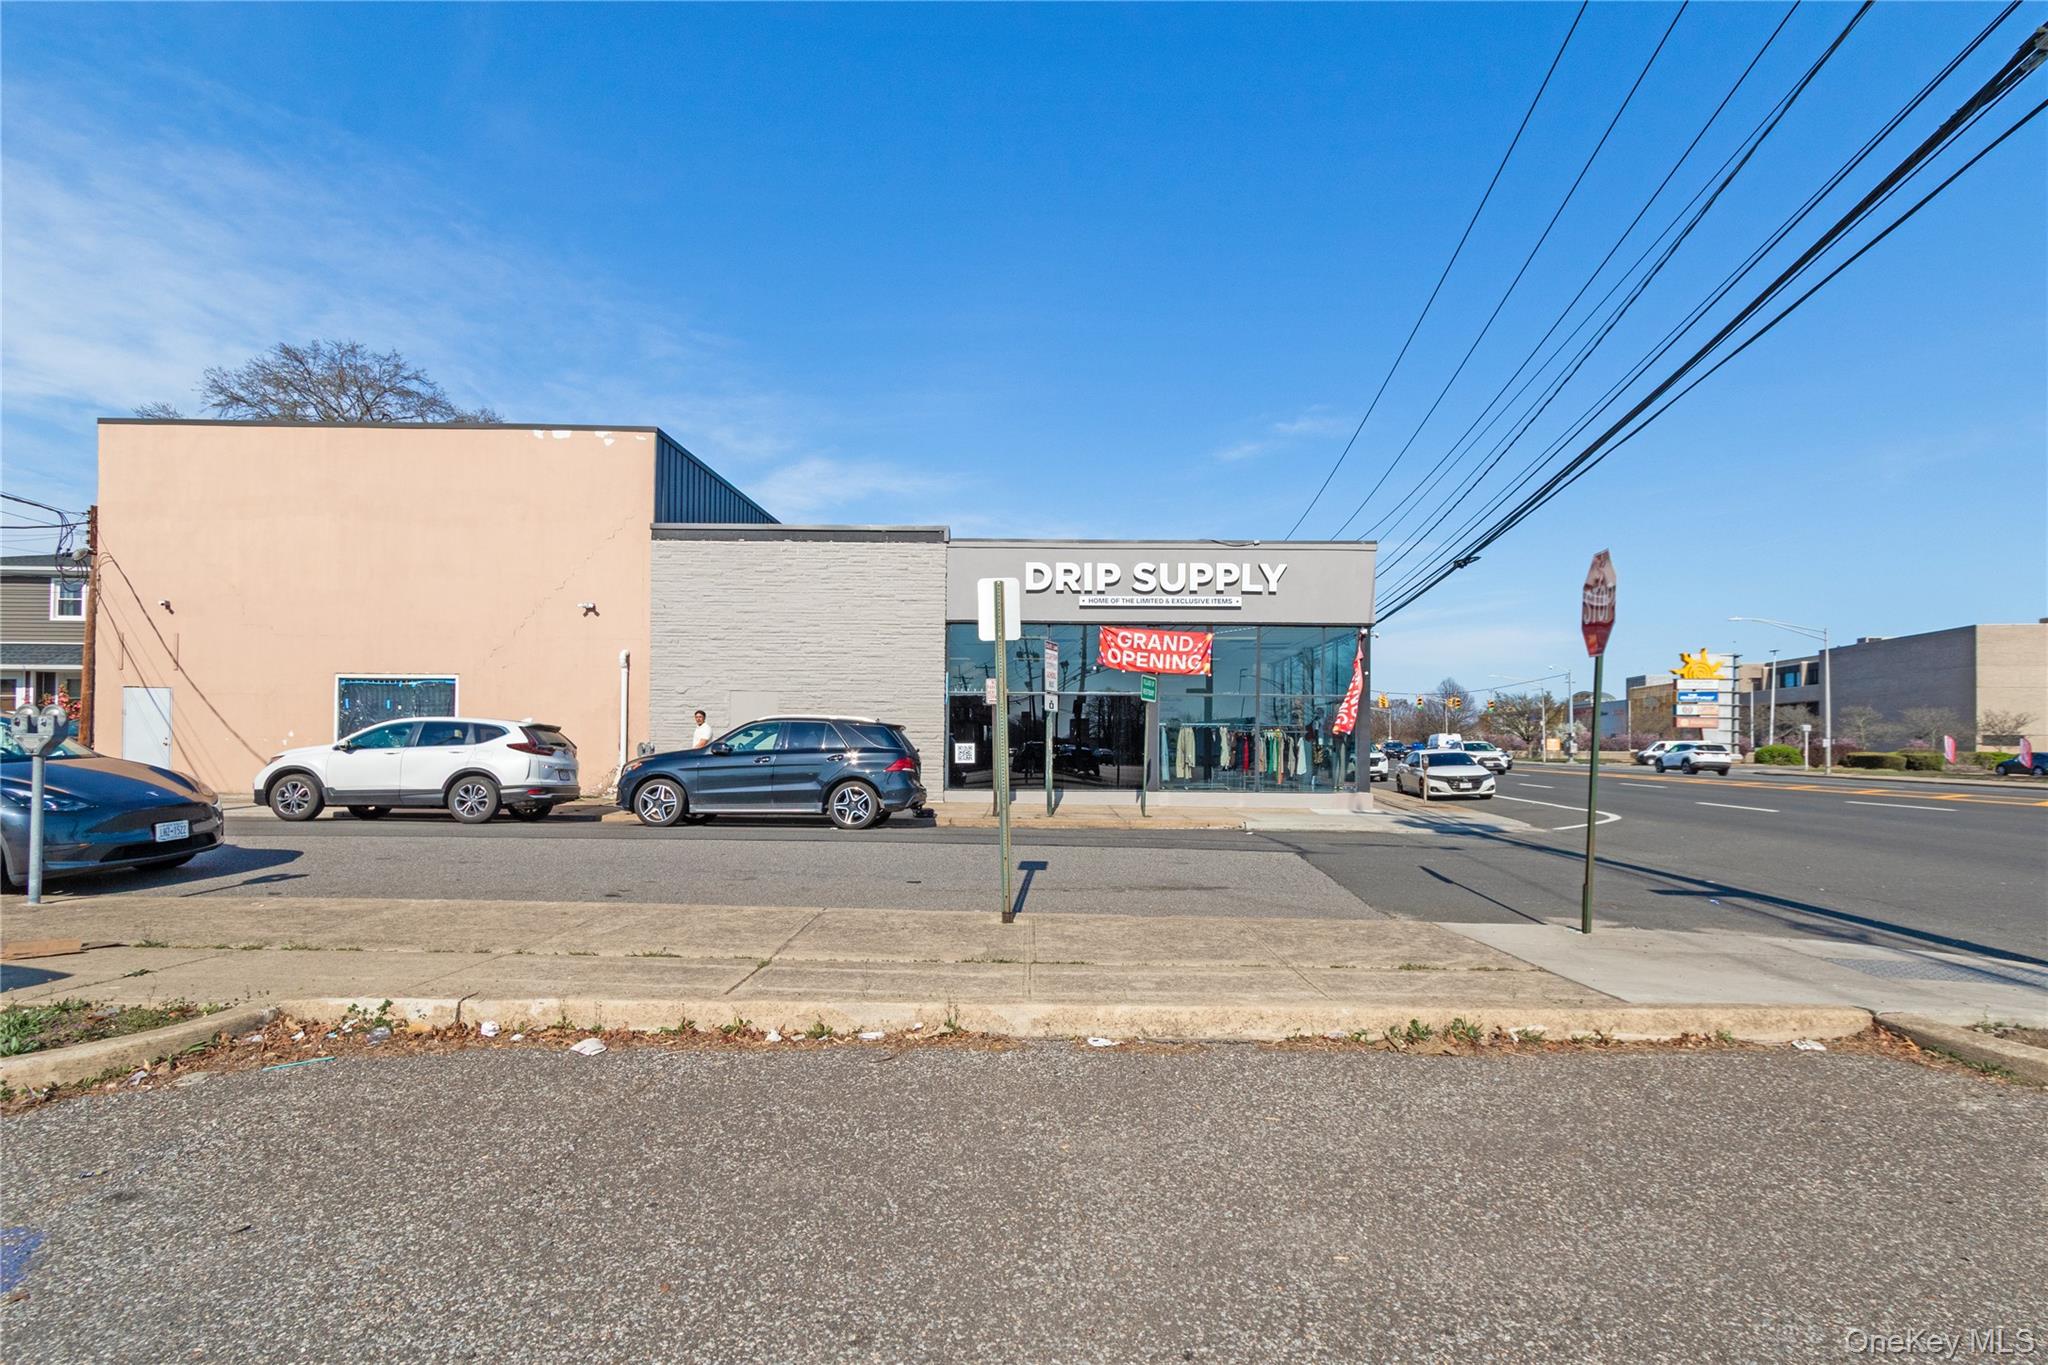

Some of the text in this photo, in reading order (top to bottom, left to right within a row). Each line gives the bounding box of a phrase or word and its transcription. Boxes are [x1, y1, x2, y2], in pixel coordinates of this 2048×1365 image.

[1025, 561, 1288, 595] DRIP SUPPLY
[1117, 631, 1194, 652] GRAND
[1107, 648, 1202, 670] OPENING
